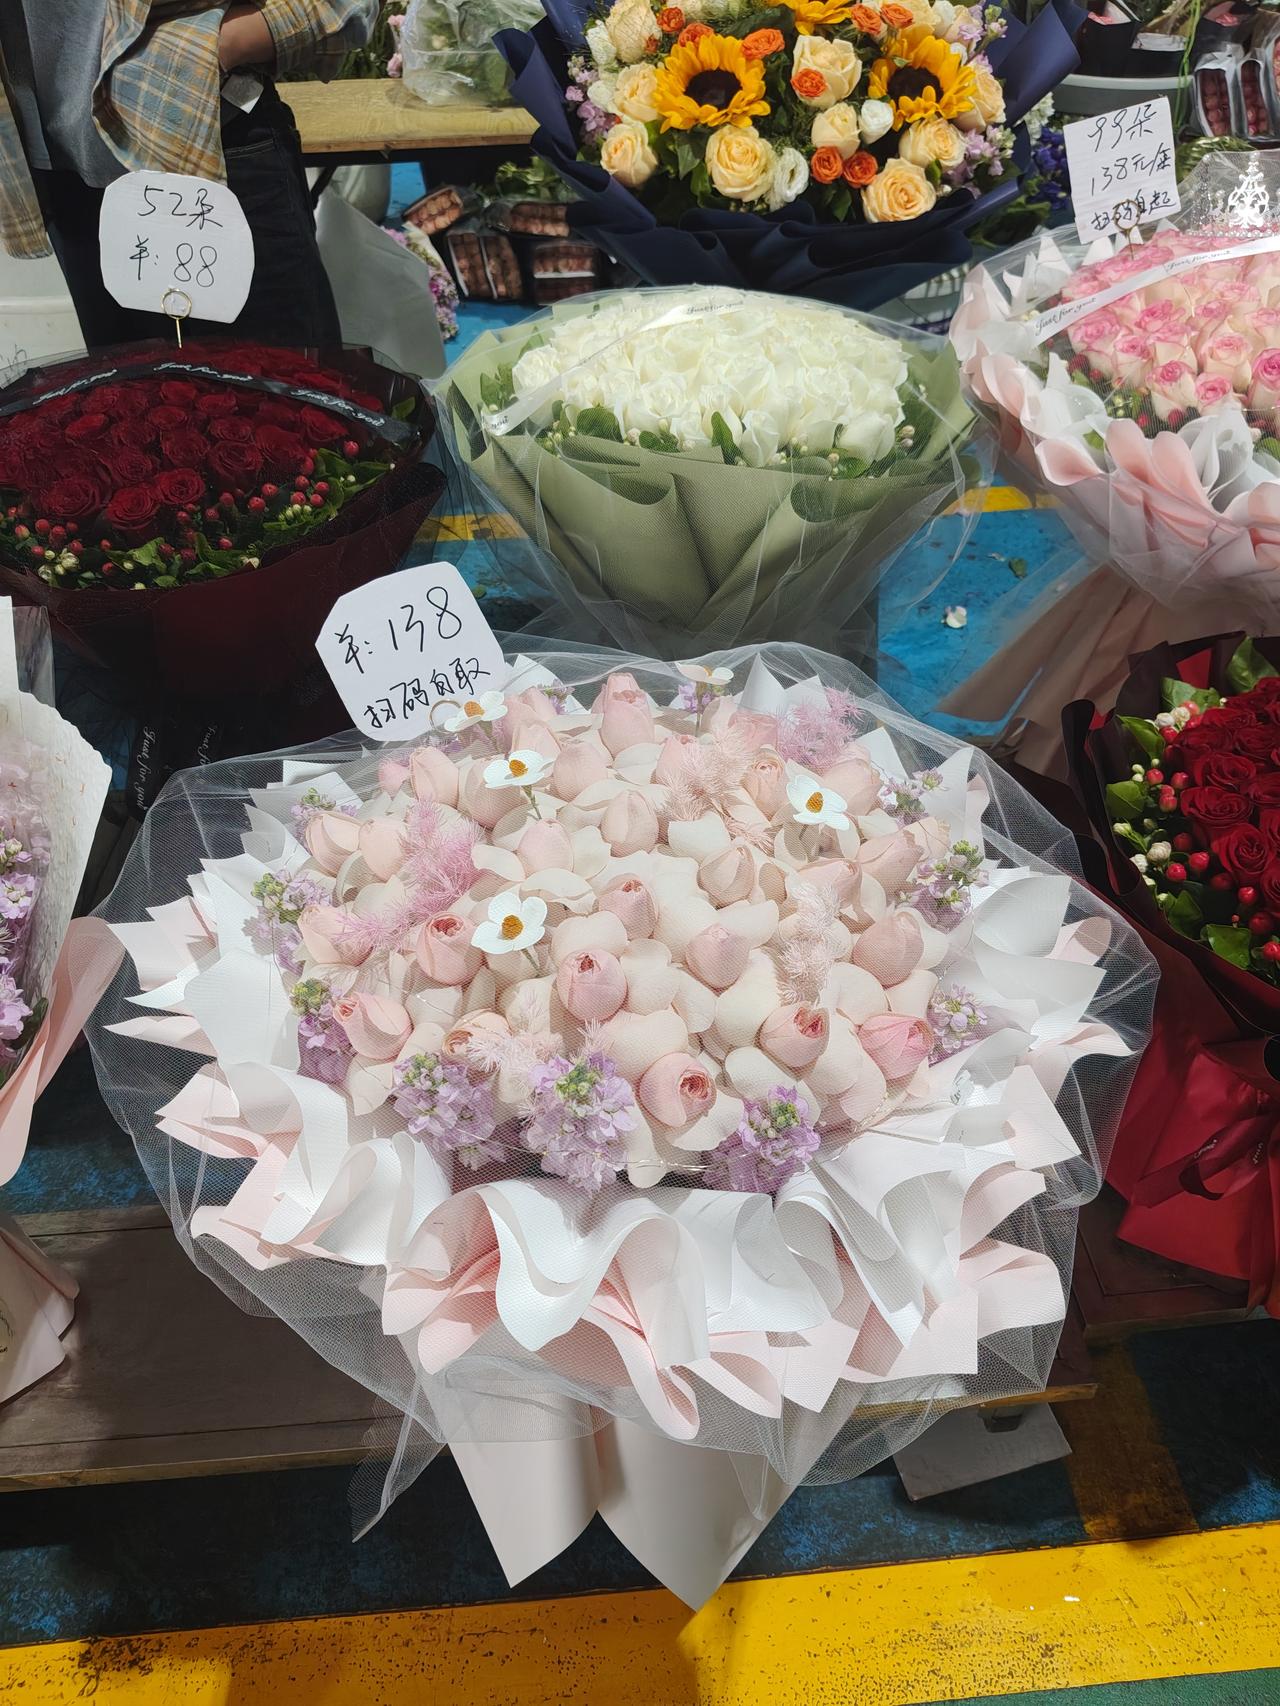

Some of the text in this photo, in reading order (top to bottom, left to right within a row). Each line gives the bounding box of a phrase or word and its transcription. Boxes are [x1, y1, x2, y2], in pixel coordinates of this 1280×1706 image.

[137, 184, 224, 231] 52朵
[363, 657, 491, 729] 扫码自取
[134, 726, 157, 810] Just for you
